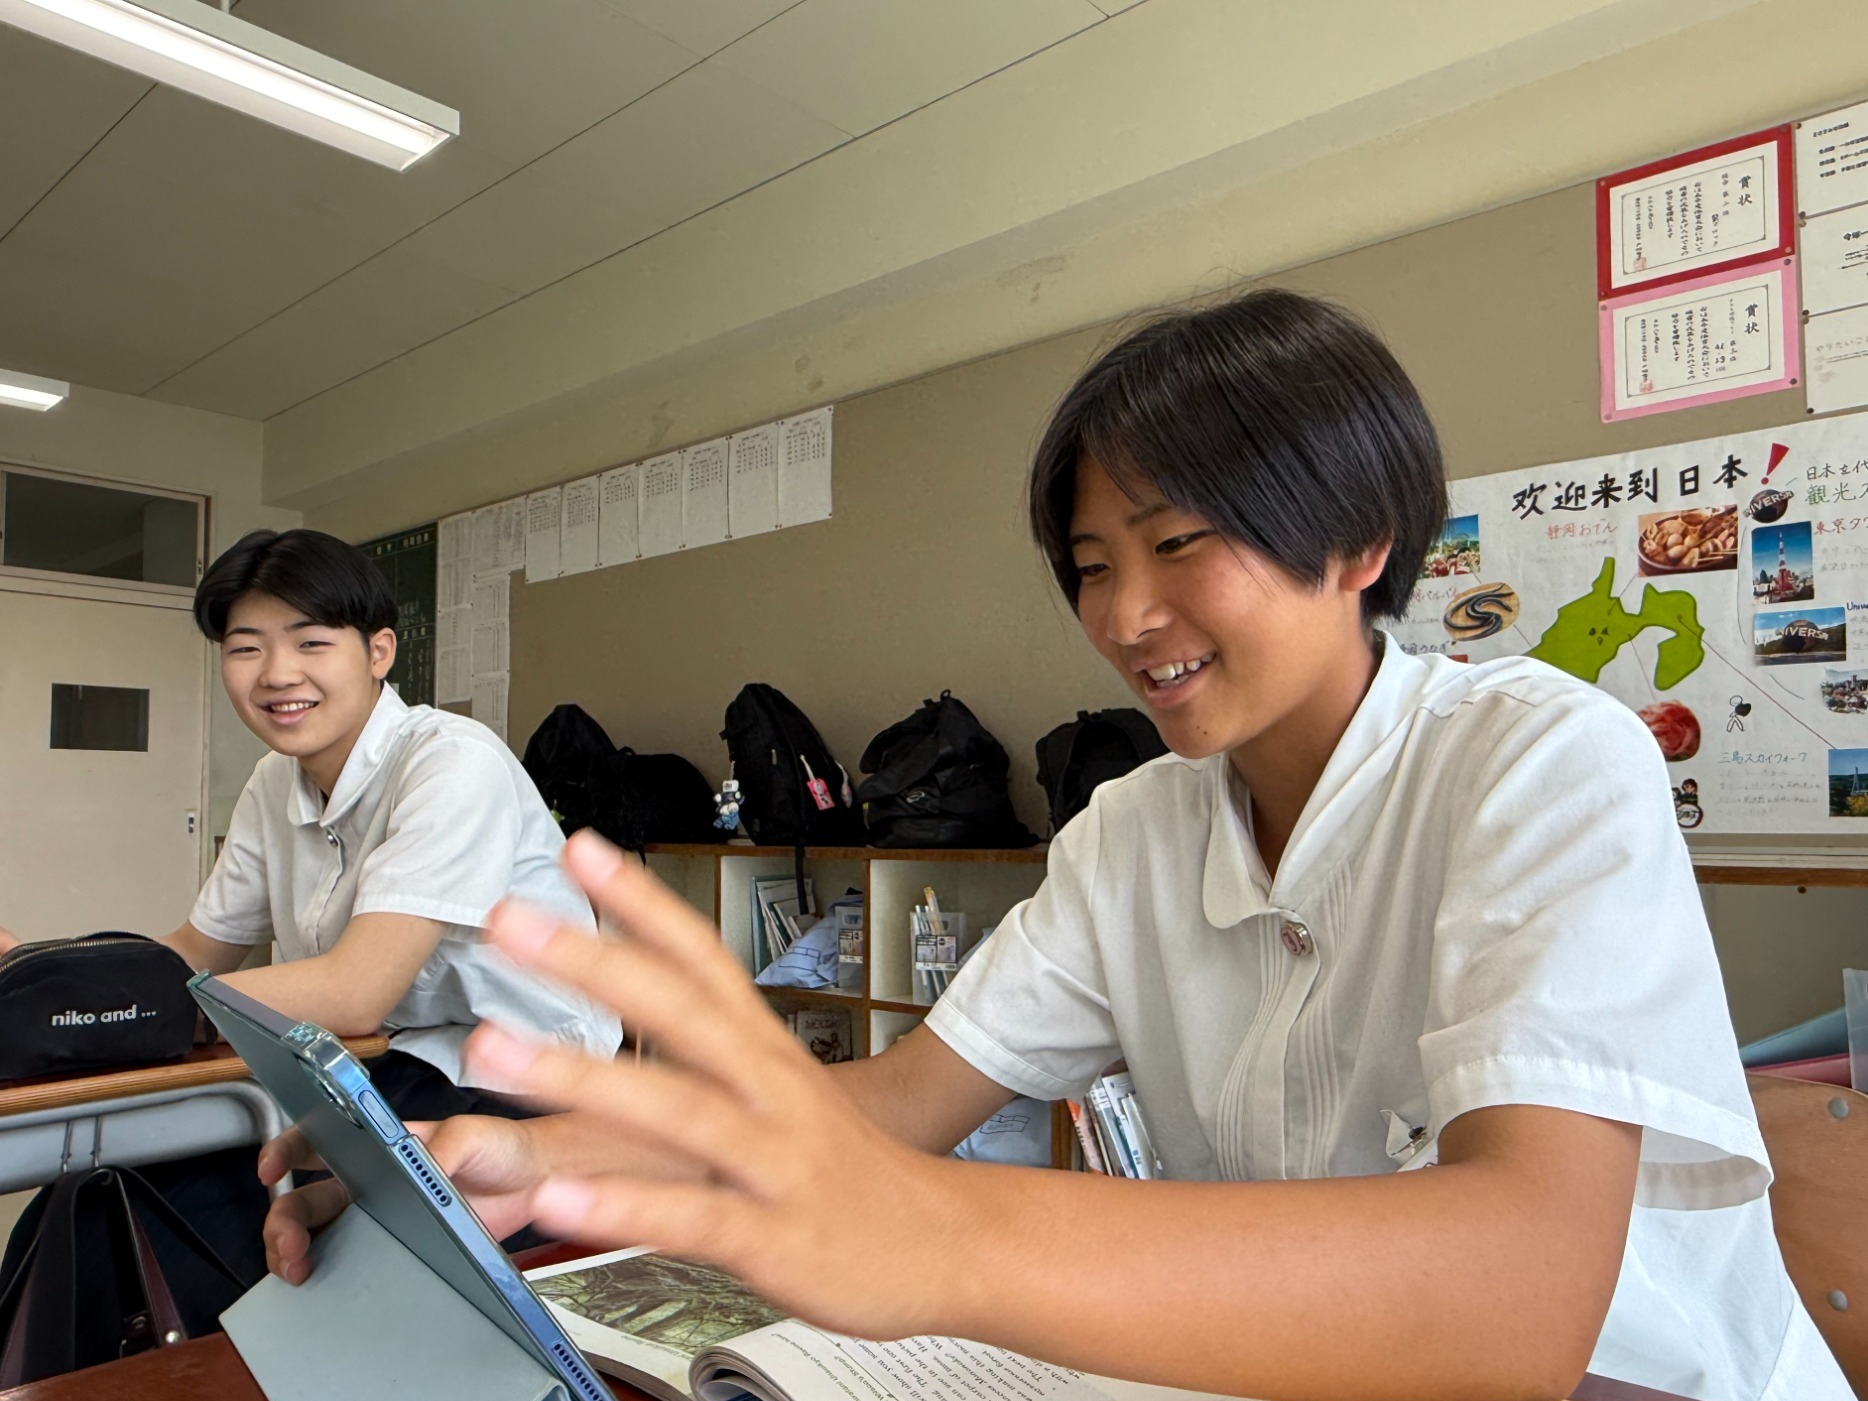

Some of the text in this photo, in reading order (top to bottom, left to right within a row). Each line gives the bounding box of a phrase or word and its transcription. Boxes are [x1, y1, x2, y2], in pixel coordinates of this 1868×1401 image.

[1738, 174, 1753, 207] 賞状
[1744, 303, 1760, 335] 賞状
[53, 1011, 96, 1026] niko
[100, 1004, 137, 1023] and
[857, 1342, 878, 1359] some
[910, 1336, 928, 1353] Hav
[882, 1346, 897, 1359] one
[876, 1359, 893, 1372] you
[894, 1358, 914, 1374] first
[913, 1357, 929, 1370] the
[968, 1354, 985, 1368] this
[1006, 1355, 1026, 1369] next
[911, 1372, 928, 1388] The
[927, 1368, 938, 1378] in
[948, 1371, 962, 1381] of
[984, 1368, 1015, 1392] making
[1026, 1368, 1043, 1381] The
[1050, 1371, 1068, 1385] with
[890, 1372, 912, 1390] show
[936, 1377, 952, 1389] see
[951, 1388, 967, 1401] can
[960, 1380, 986, 1401] carpet
